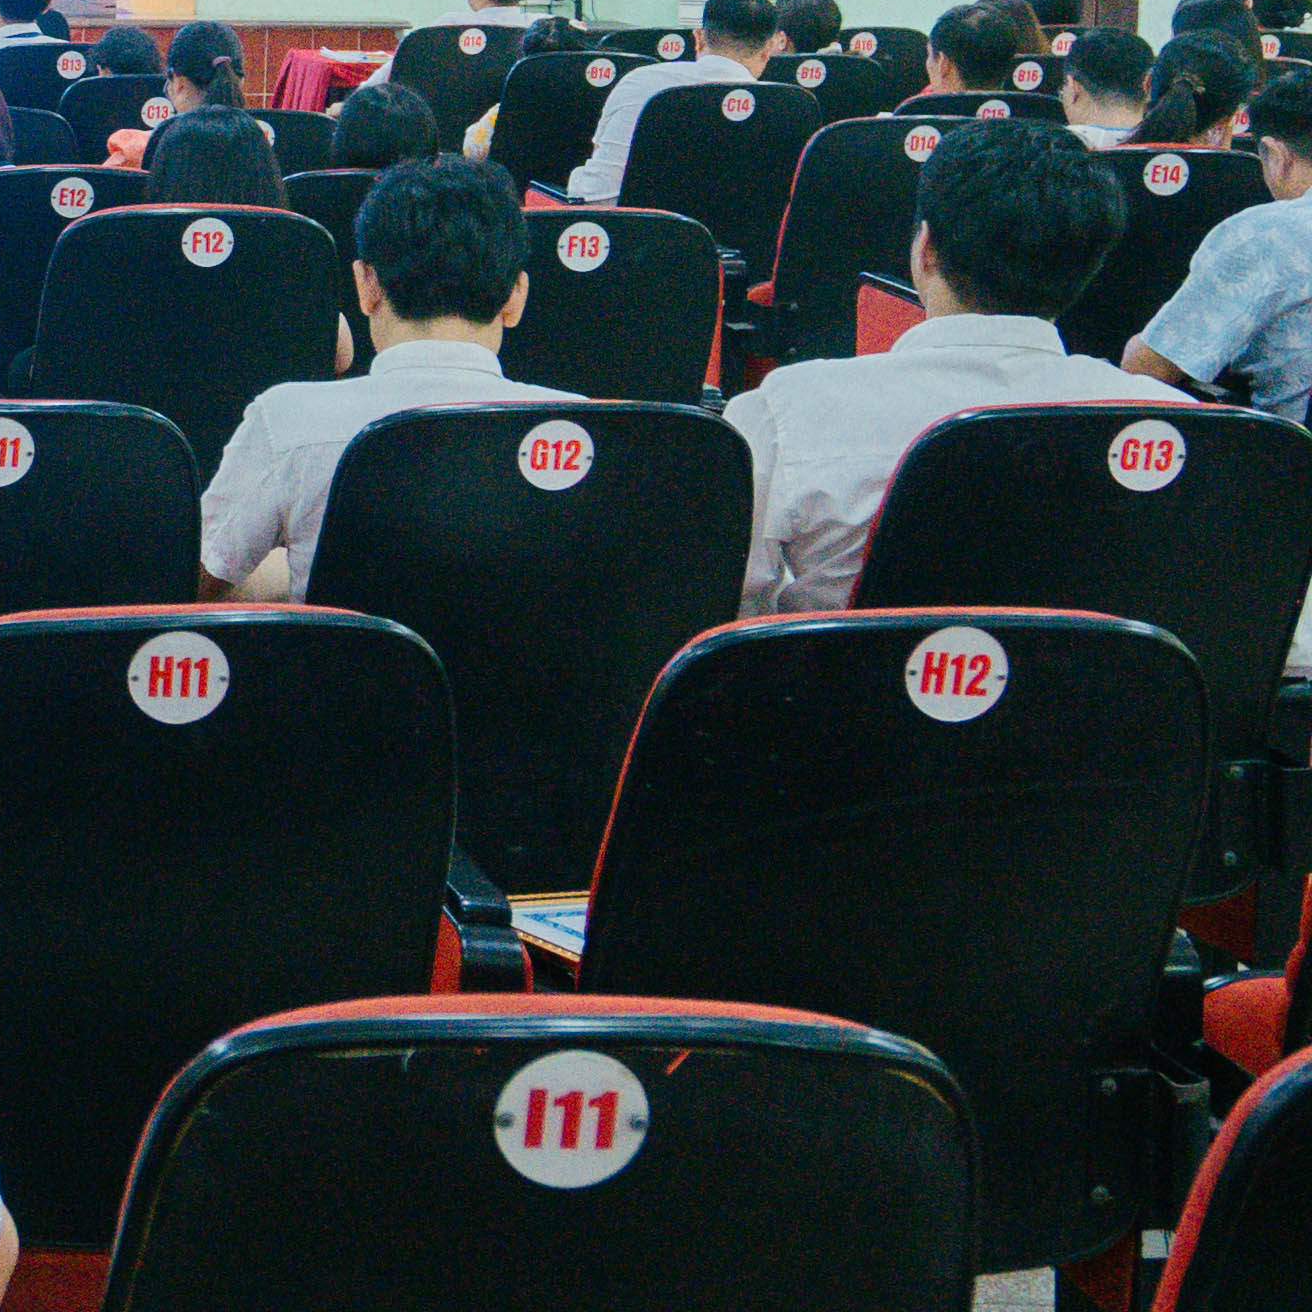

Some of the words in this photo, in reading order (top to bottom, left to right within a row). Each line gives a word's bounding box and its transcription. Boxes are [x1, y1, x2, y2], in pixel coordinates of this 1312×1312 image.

[61, 58, 83, 72] B13
[589, 66, 612, 80] B14
[801, 66, 822, 80] B15
[726, 97, 751, 113] C14
[1152, 164, 1181, 183] E14
[59, 188, 88, 208] E12
[192, 231, 224, 253] F12
[568, 235, 599, 258] F13
[530, 439, 581, 471] G12
[1120, 438, 1174, 472] G13
[148, 655, 210, 698] H11
[920, 651, 992, 696] H12
[523, 1088, 619, 1149] I11
